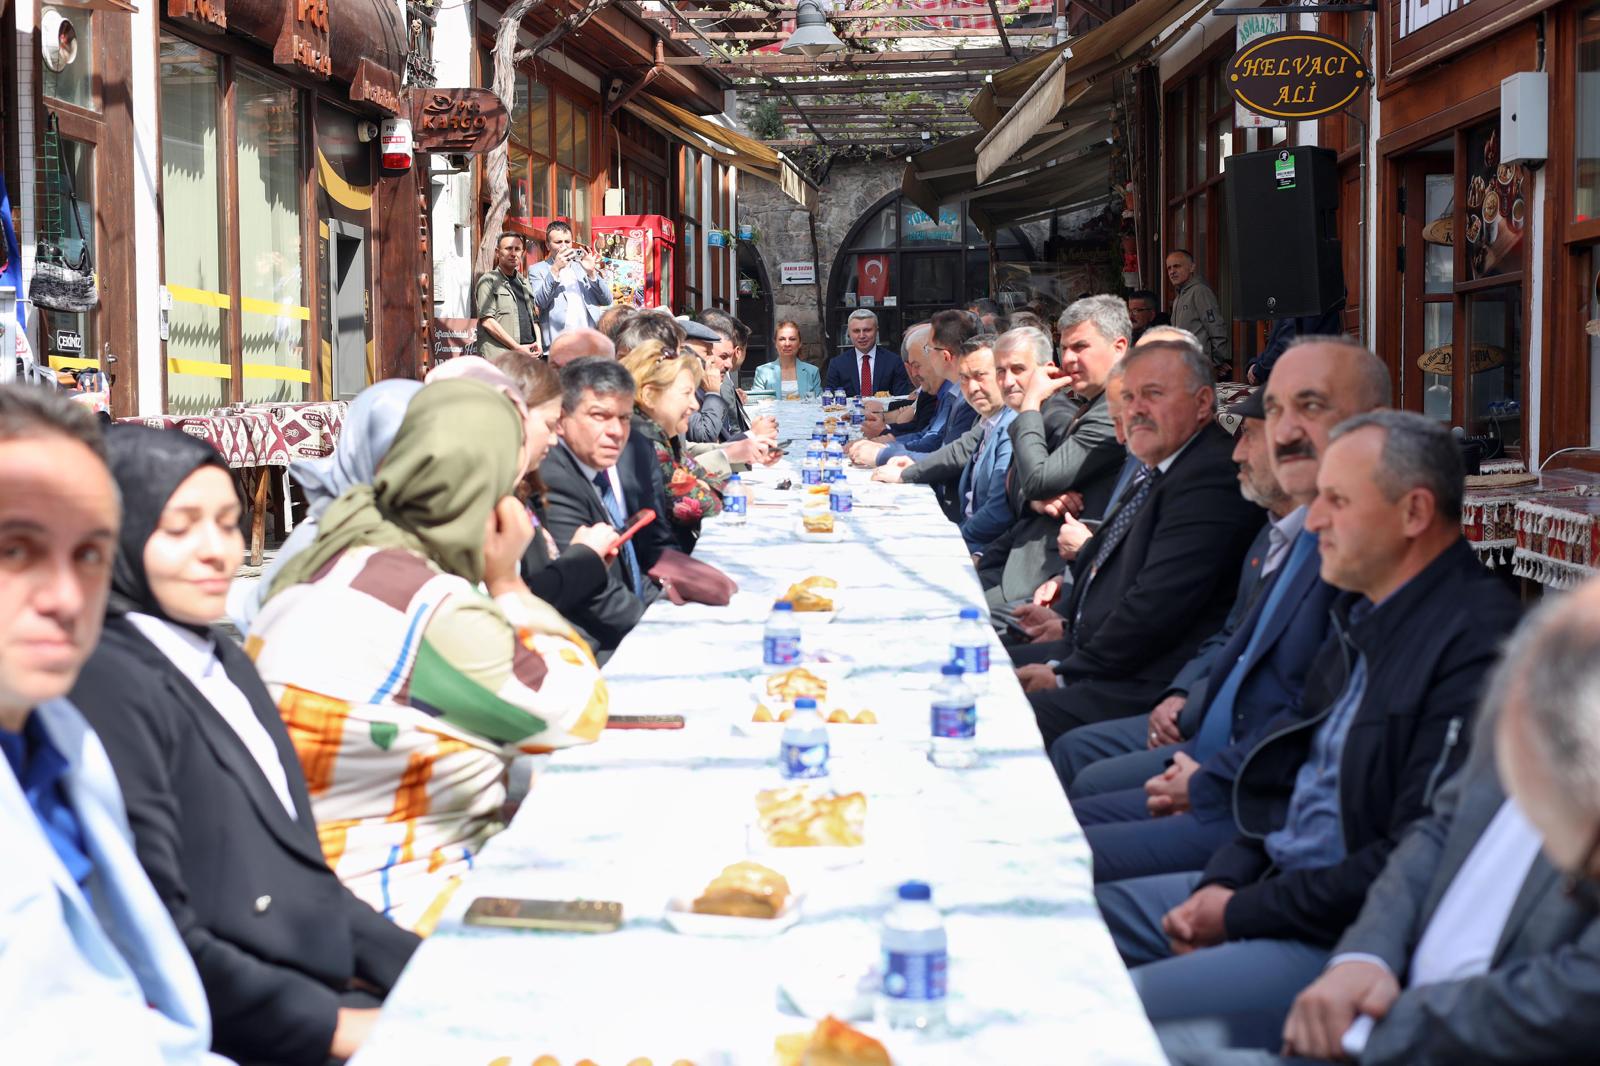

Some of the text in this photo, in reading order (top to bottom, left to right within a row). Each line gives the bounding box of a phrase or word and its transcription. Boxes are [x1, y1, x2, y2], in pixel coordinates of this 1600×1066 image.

[1242, 54, 1348, 77] HELVACI
[1273, 81, 1317, 106] ALİ
[423, 115, 487, 130] KARGO
[59, 334, 81, 349] ÇEKİNİZ
